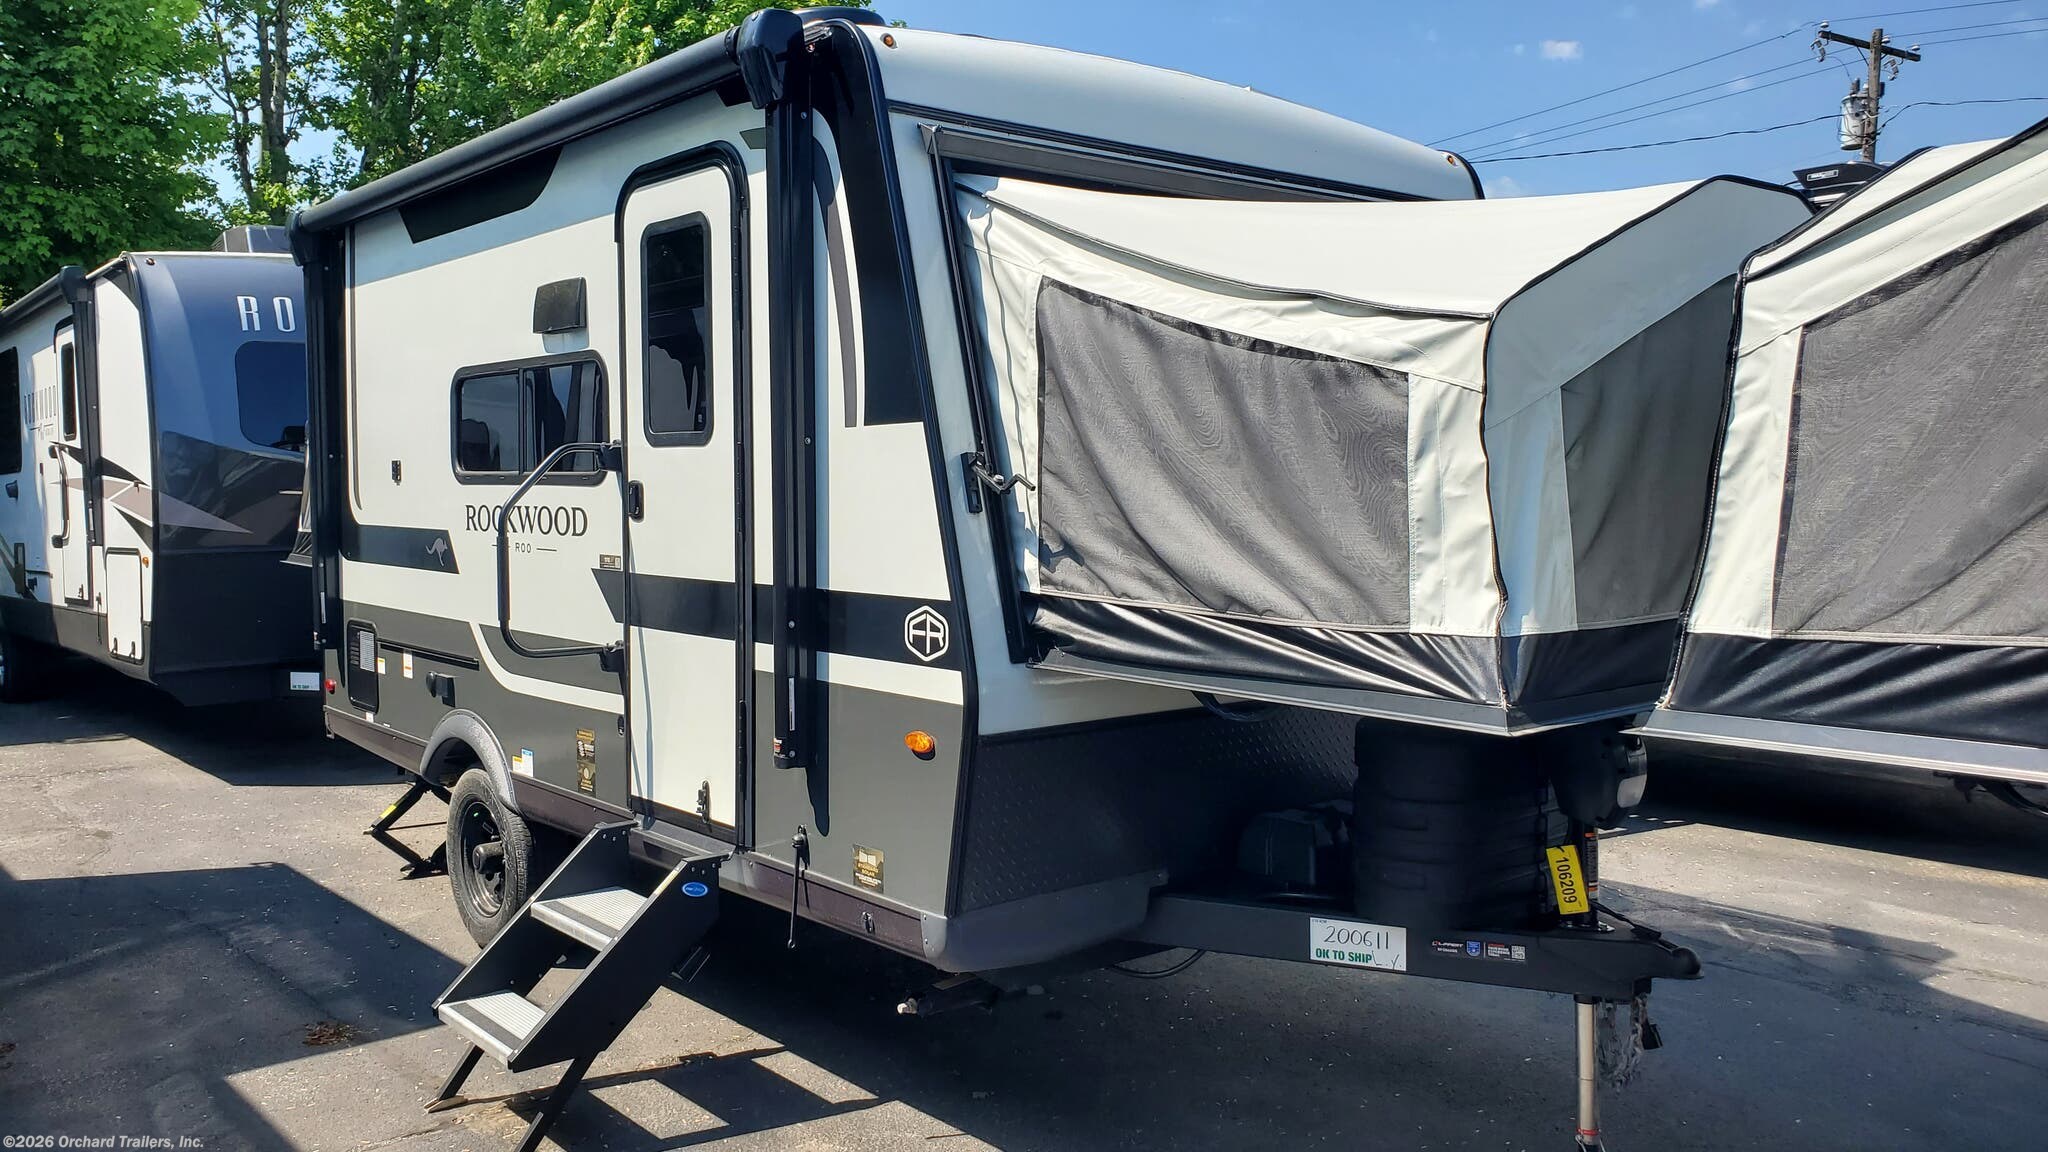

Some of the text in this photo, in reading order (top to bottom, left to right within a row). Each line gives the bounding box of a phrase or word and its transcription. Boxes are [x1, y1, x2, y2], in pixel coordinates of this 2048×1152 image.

[515, 542, 532, 554] ROO
[1555, 856, 1578, 904] 106209
[1323, 925, 1389, 950] 200611
[1315, 947, 1373, 964] OK TO SHIP
